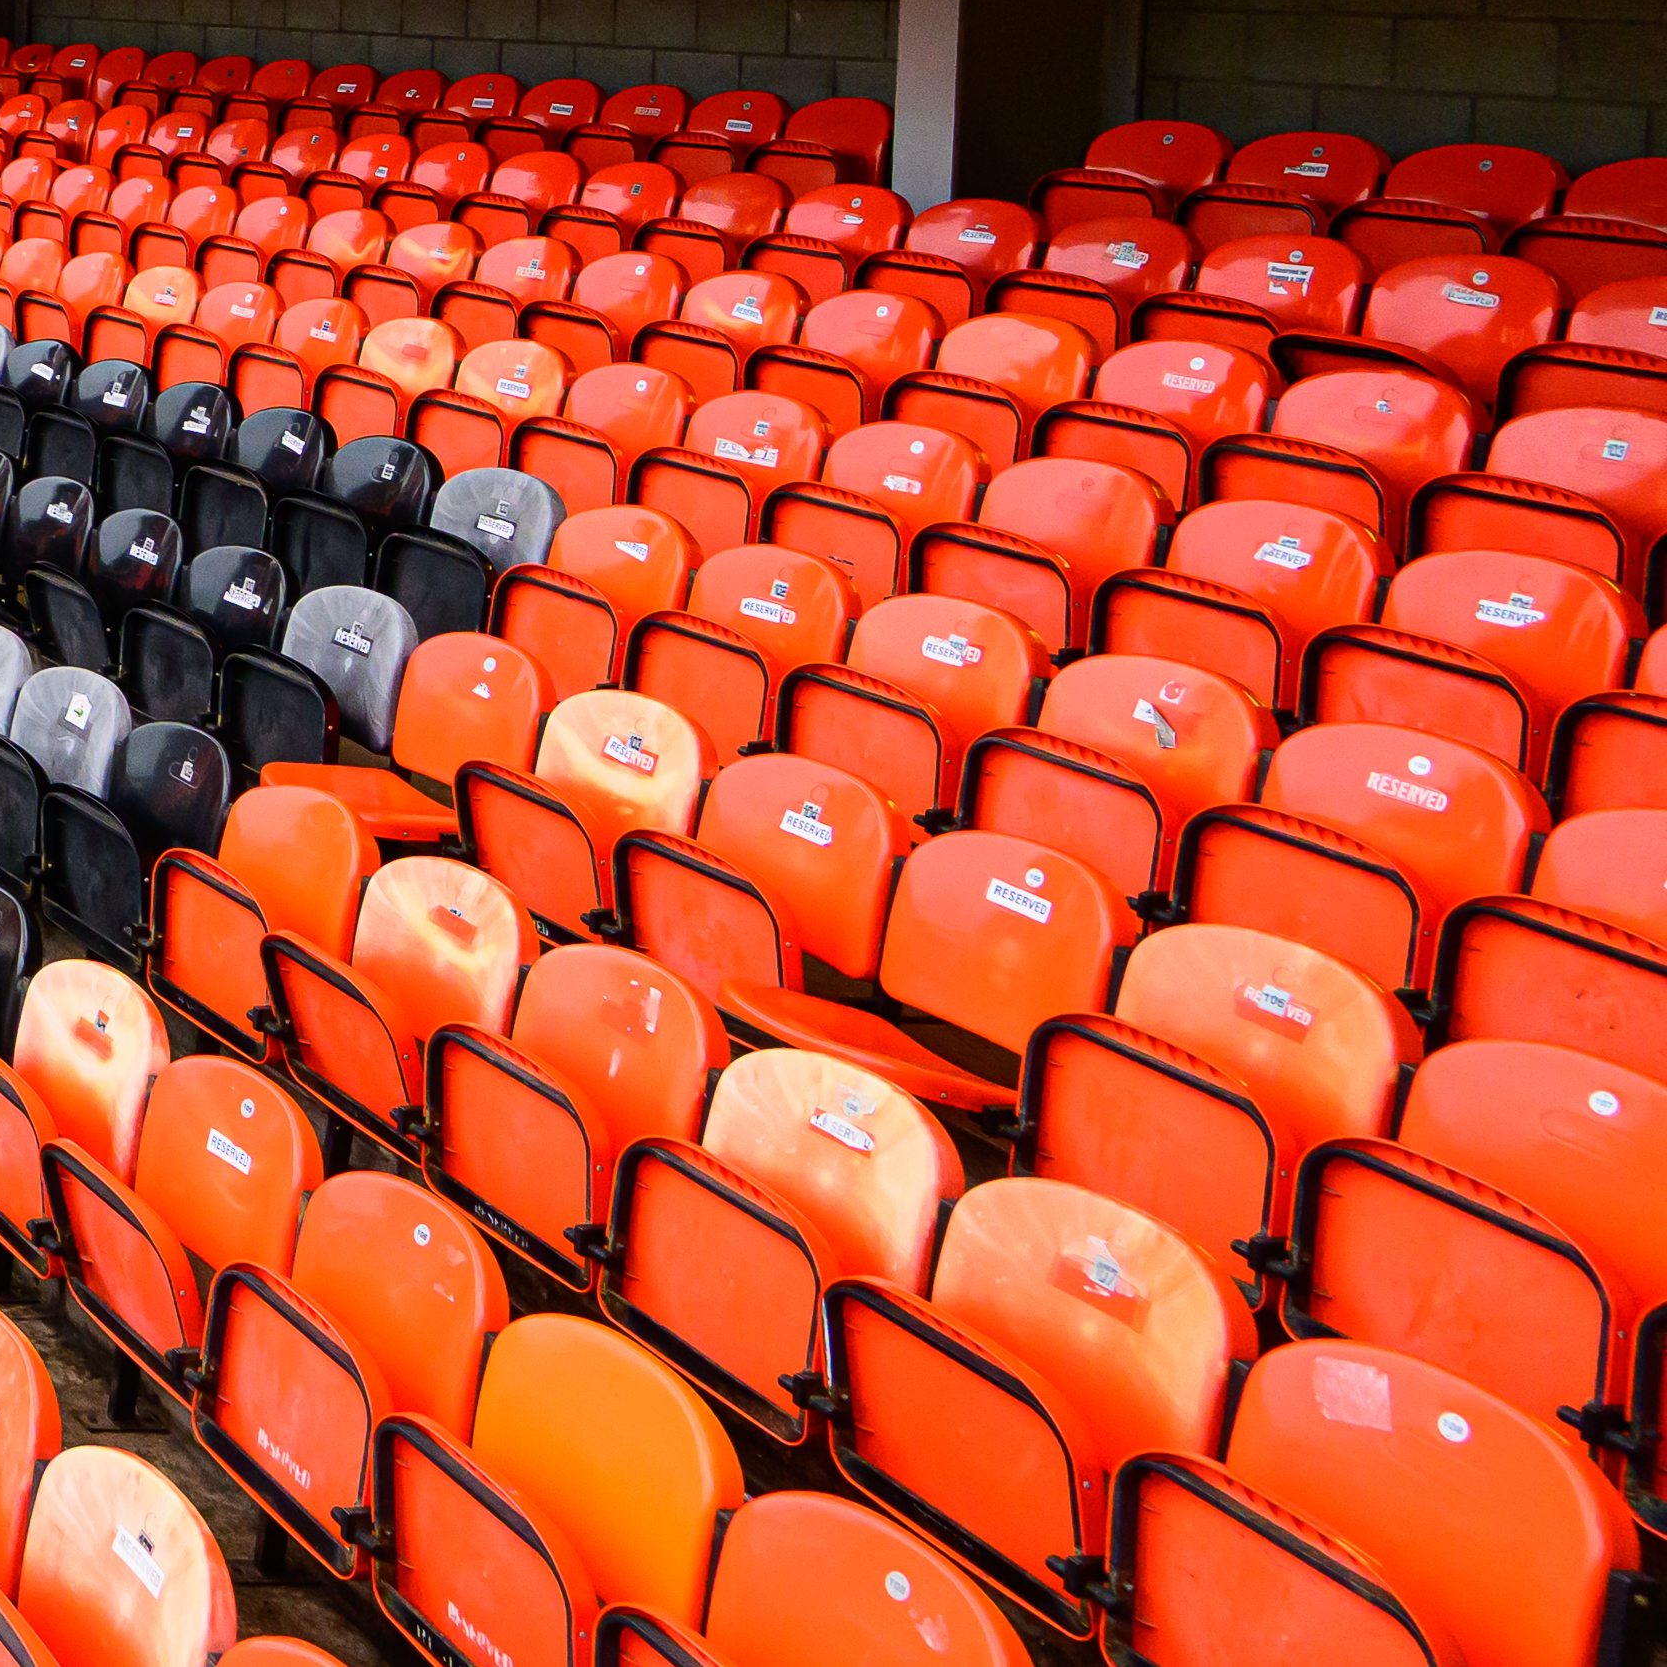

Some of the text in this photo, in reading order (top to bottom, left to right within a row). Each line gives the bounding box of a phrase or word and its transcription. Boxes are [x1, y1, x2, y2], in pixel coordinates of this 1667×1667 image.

[1162, 373, 1216, 394] RESERVED
[1367, 771, 1448, 812] RESERVED
[785, 815, 831, 842] RESERVED
[992, 884, 1049, 917] RESERVED
[210, 1134, 250, 1169] RESERVED
